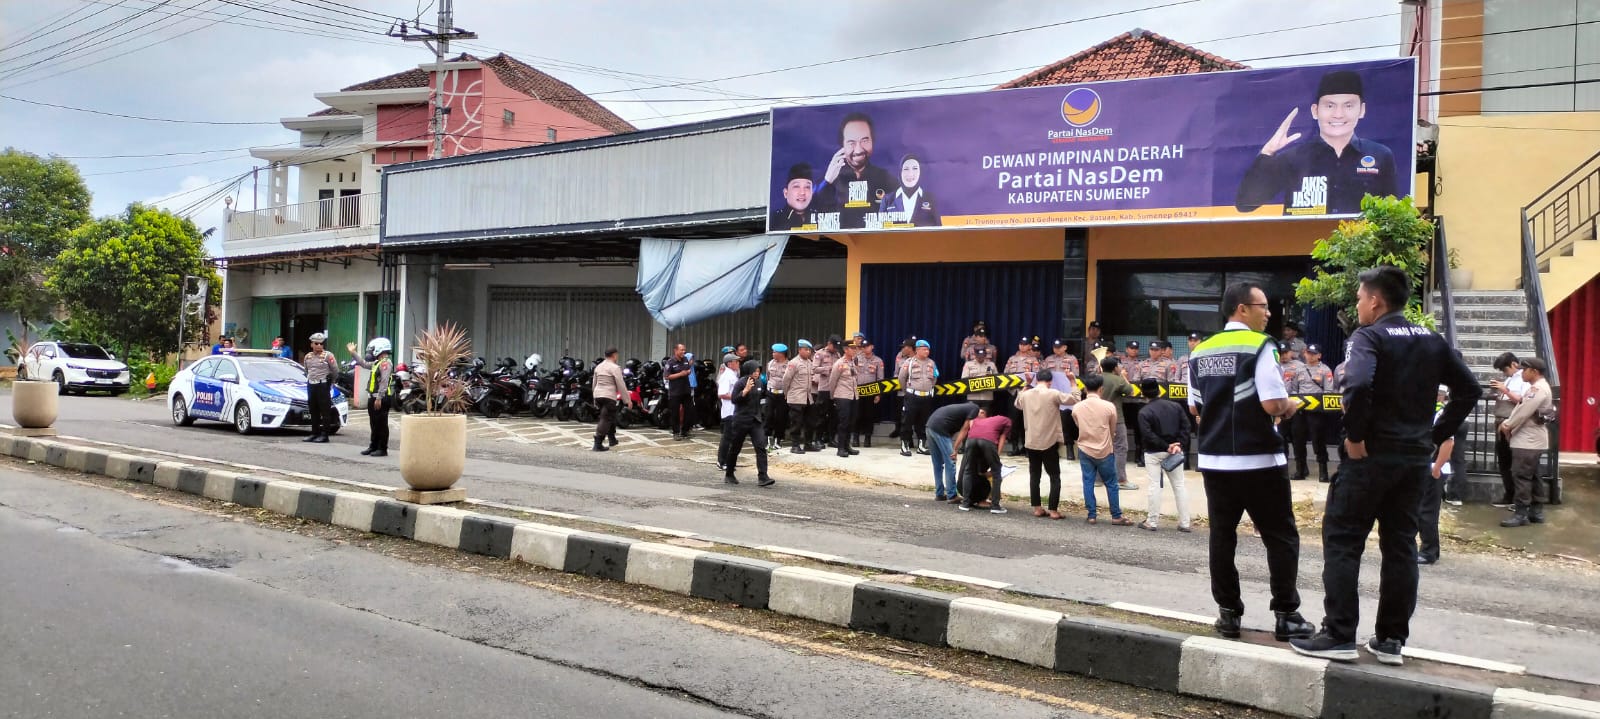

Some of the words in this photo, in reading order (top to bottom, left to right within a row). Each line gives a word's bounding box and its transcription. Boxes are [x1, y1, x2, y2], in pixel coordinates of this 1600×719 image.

[1048, 129, 1073, 138] Partai
[1076, 127, 1113, 137] NasDem
[982, 152, 1035, 169] DEWAN
[1038, 148, 1115, 167] PIMPINAN
[1118, 144, 1184, 162] DAERAH
[998, 168, 1062, 189] Partai
[1068, 165, 1164, 186] NasDem
[1302, 175, 1328, 192] AKIS
[1008, 188, 1083, 204] KABUPATEN
[1086, 186, 1150, 201] SUMENEP
[1291, 191, 1327, 207] JASULI
[1137, 212, 1173, 221] Sumenep
[970, 378, 994, 390] POLISI
[196, 391, 213, 401] POLISI
[1170, 386, 1188, 397] POLI
